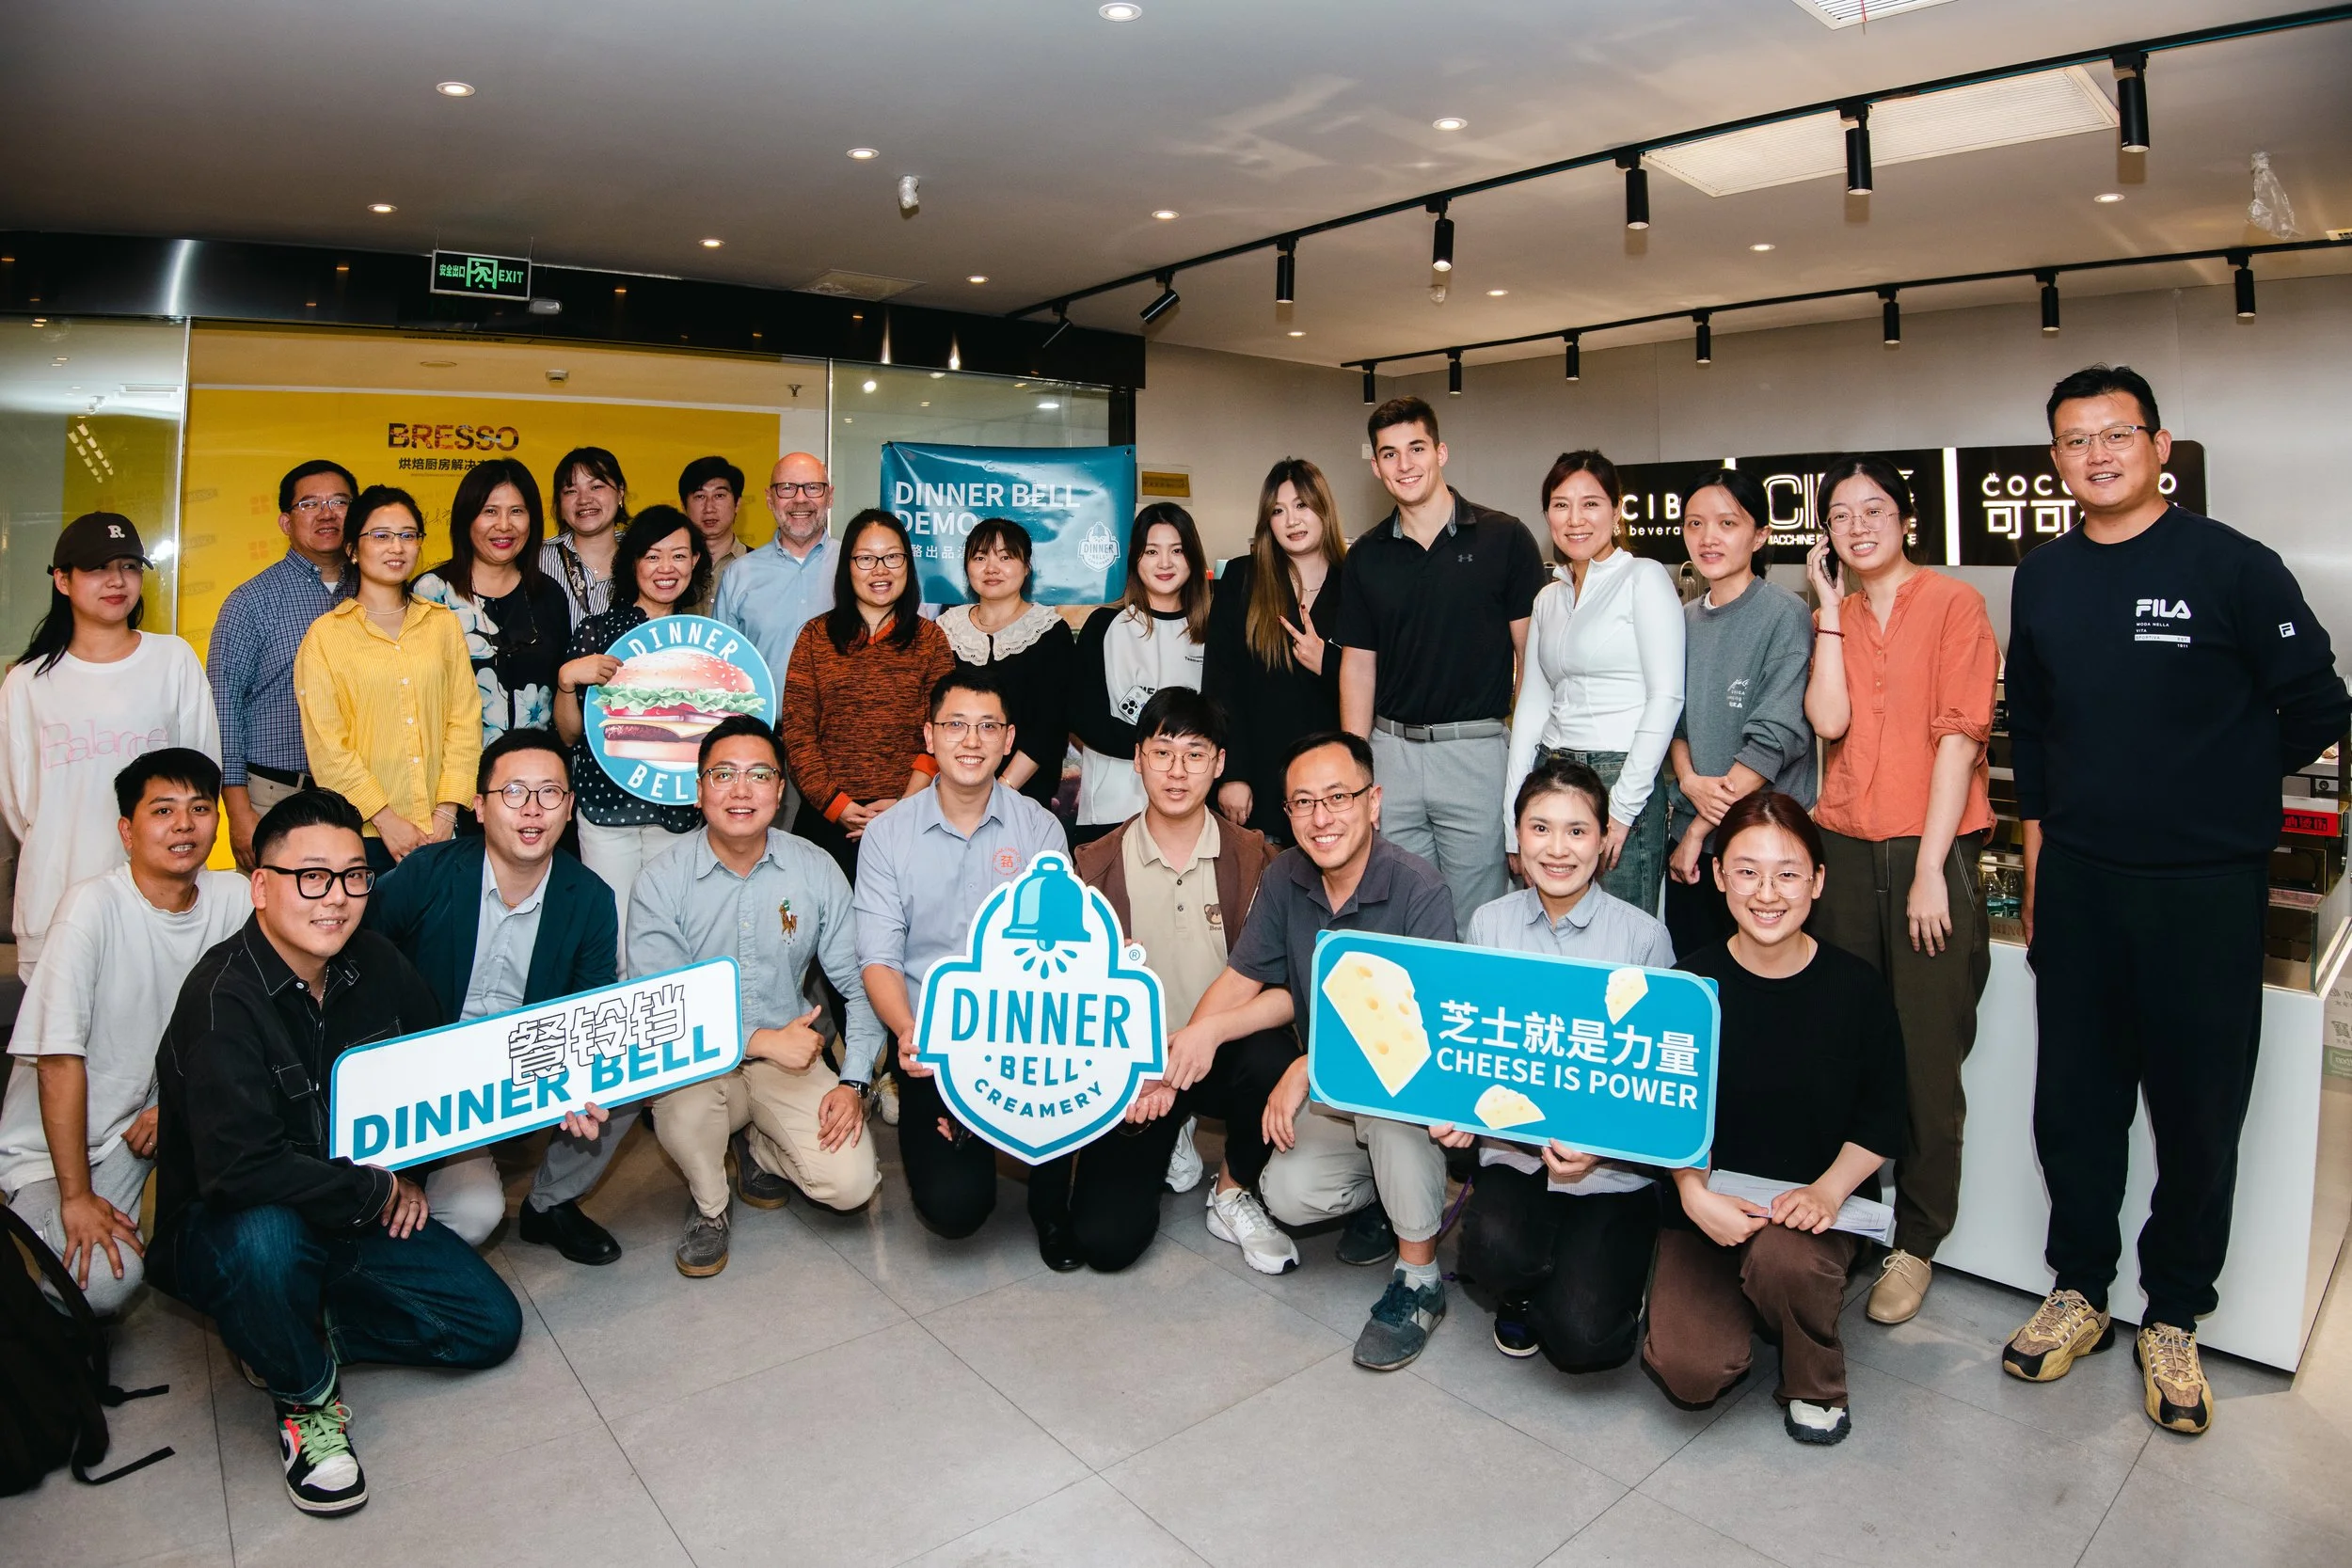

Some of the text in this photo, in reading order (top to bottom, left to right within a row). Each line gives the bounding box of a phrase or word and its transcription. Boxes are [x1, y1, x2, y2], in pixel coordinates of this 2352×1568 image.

[438, 263, 466, 278] 安全出口
[498, 269, 524, 284] EXIT
[388, 422, 520, 451] BRESSO
[398, 457, 489, 471] 烘焙厨房解决
[895, 481, 1081, 508] DINNER BELL
[1621, 493, 1681, 521] CIB
[107, 525, 125, 539] R
[1629, 524, 1681, 536] bevera
[1982, 499, 2085, 540] 可可
[2136, 598, 2191, 620] FILA
[628, 622, 739, 660] DINNER
[628, 764, 700, 800] BEL
[507, 983, 686, 1086] 餐铃铛
[951, 988, 1131, 1049] DINNER
[1437, 999, 1700, 1078] 芝士就是力量
[1000, 1054, 1079, 1086] BELL
[1436, 1047, 1699, 1111] CHEESE IS POWER
[353, 1024, 722, 1161] DINNER BELL
[974, 1078, 1103, 1118] CREAMERY
